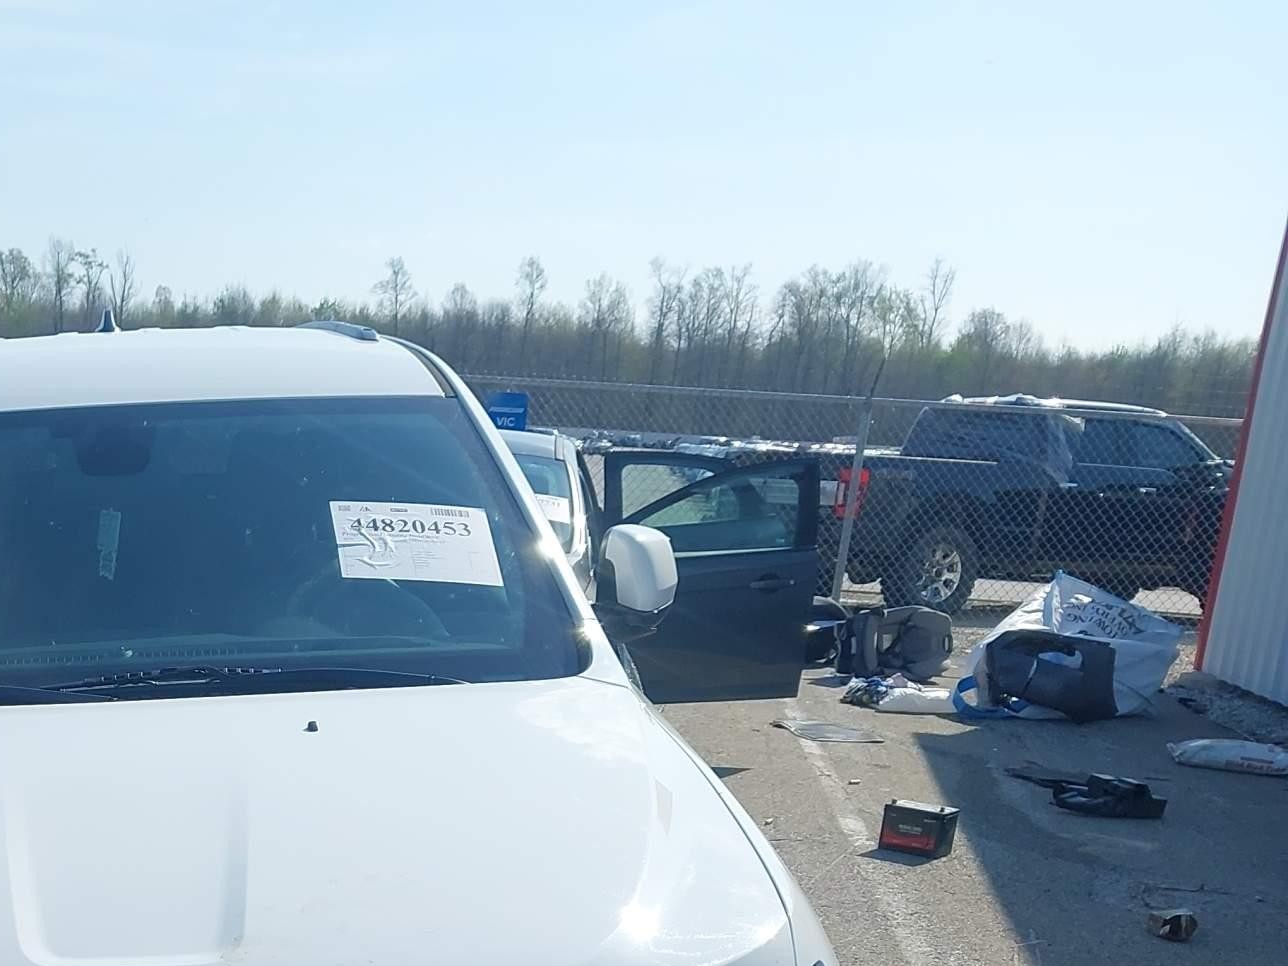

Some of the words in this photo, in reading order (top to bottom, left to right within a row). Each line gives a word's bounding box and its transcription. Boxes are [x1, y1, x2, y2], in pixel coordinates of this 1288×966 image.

[496, 416, 516, 427] VIC
[350, 518, 472, 537] 44820453
[1066, 612, 1119, 639] TOWING
